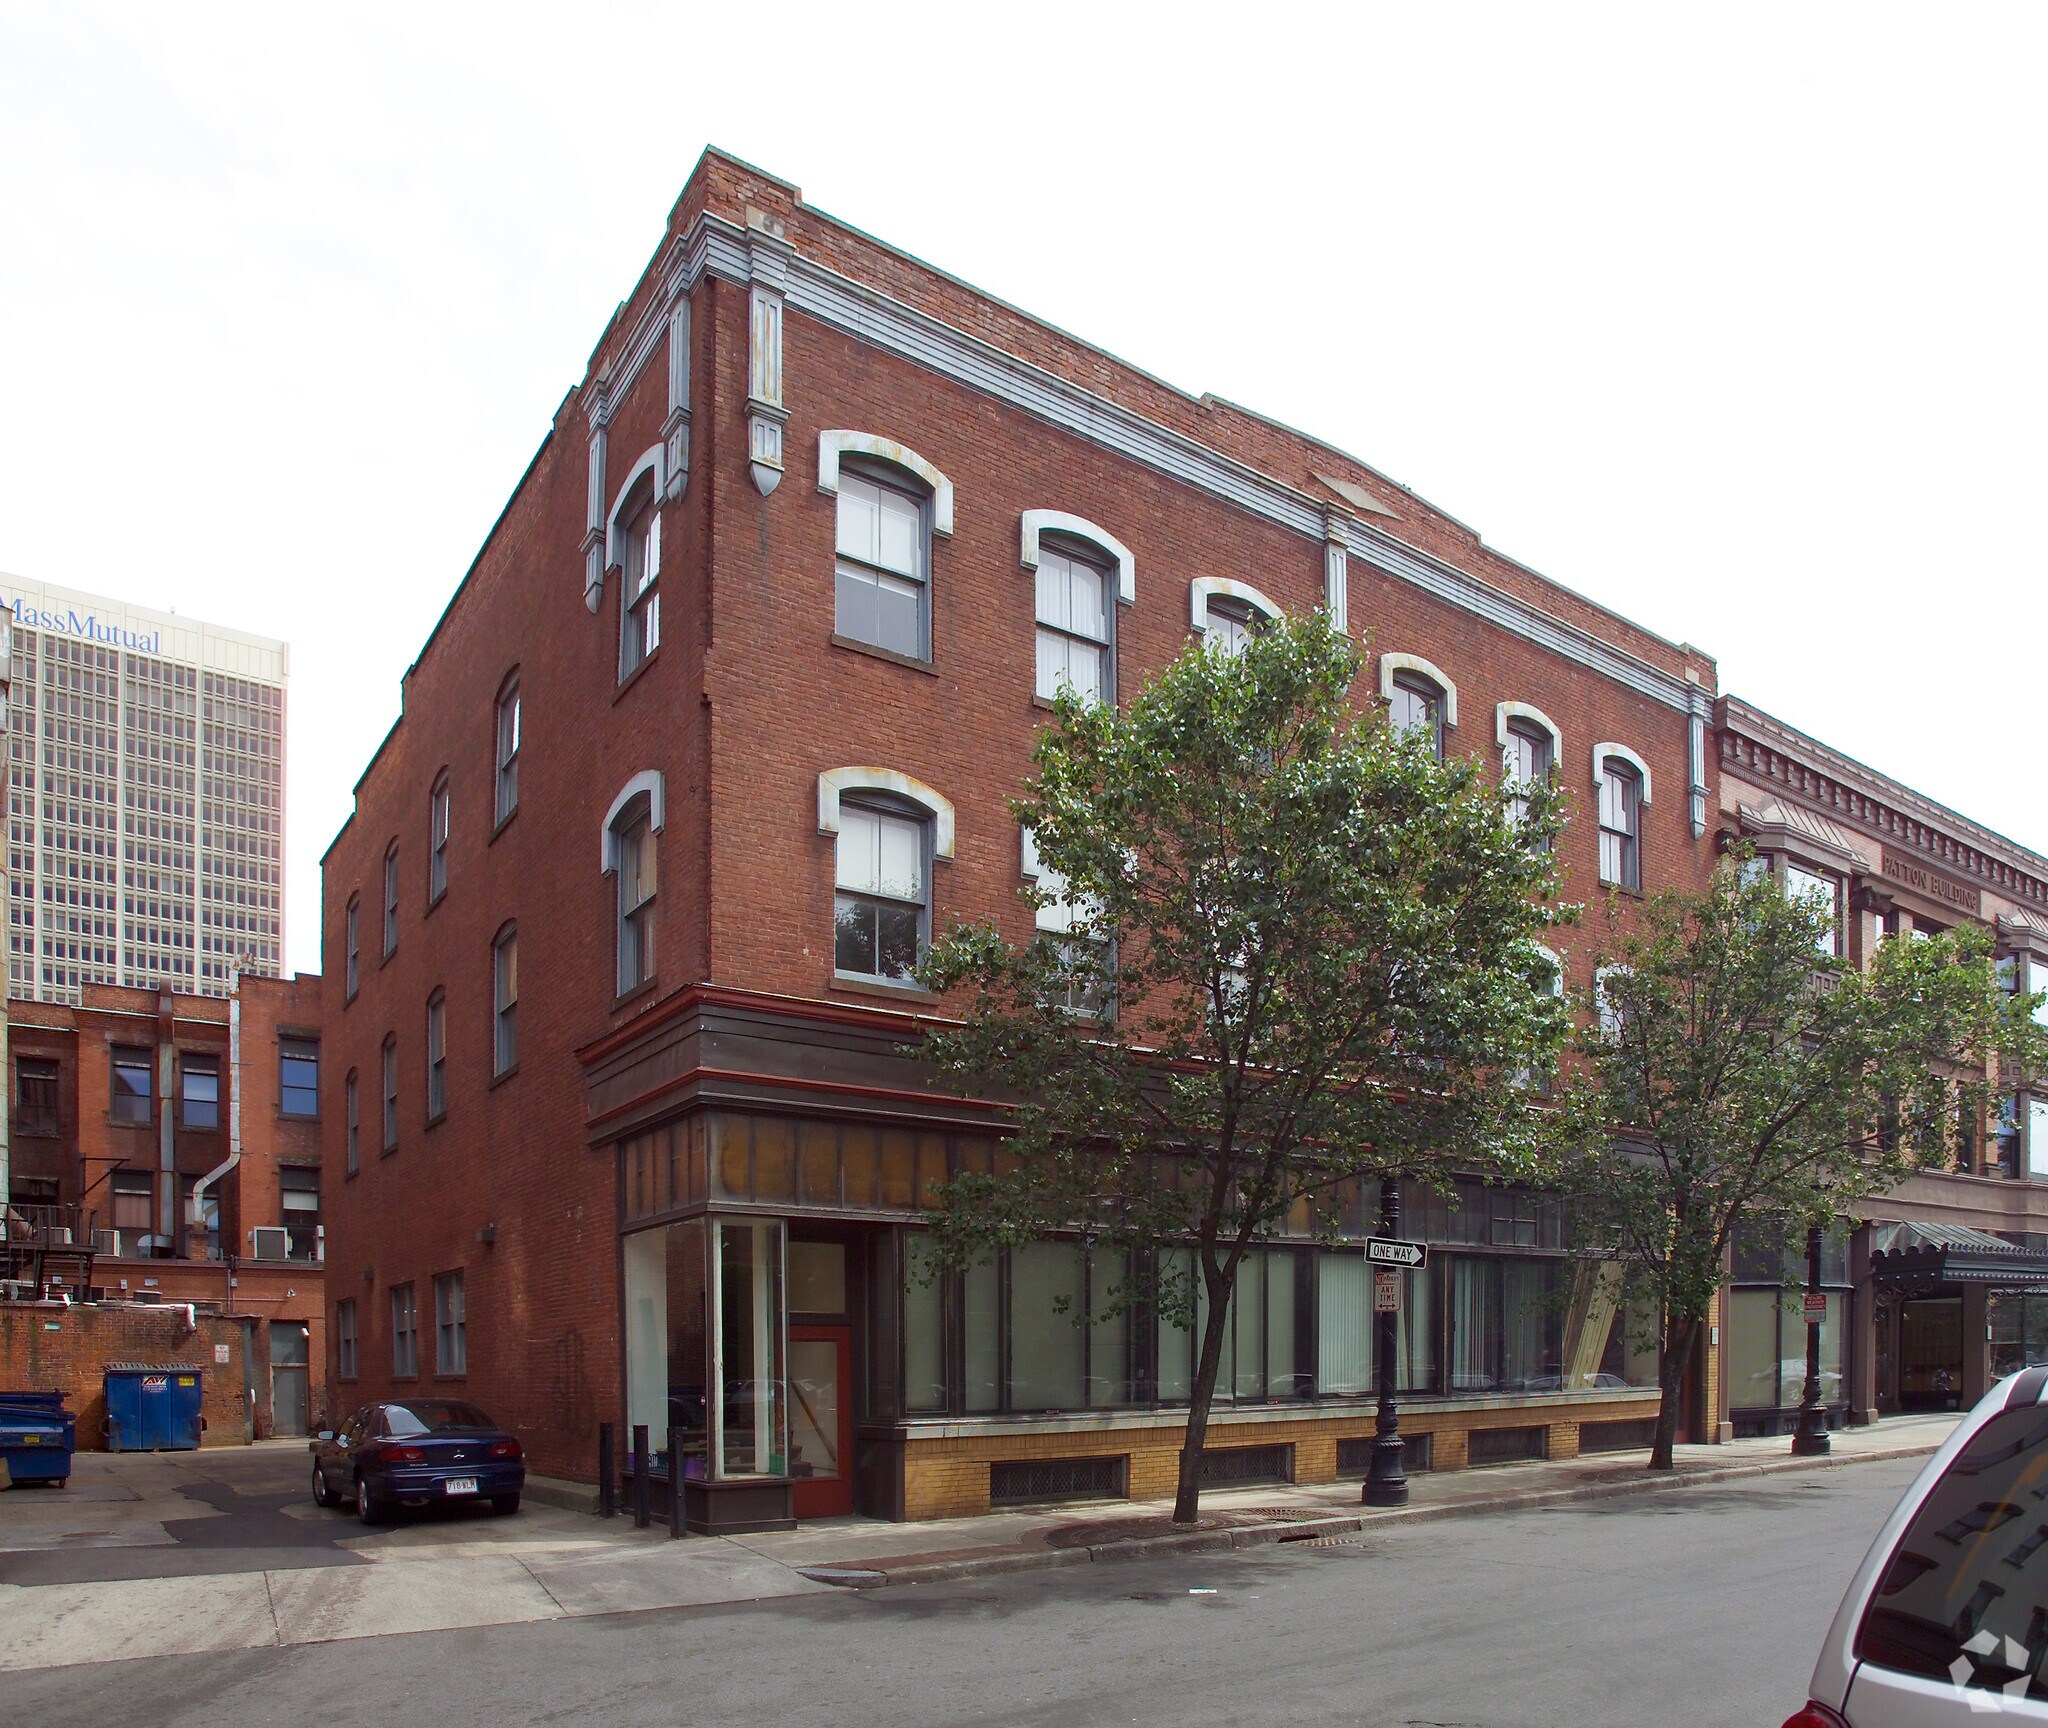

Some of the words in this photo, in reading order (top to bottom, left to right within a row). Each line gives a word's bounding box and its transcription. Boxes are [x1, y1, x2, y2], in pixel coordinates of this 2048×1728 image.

[0, 595, 159, 653] MassMutual
[1883, 854, 1927, 889] PATTON
[1931, 876, 1977, 909] BUILDING
[1373, 1244, 1391, 1258] ONE
[1393, 1247, 1413, 1260] WAY
